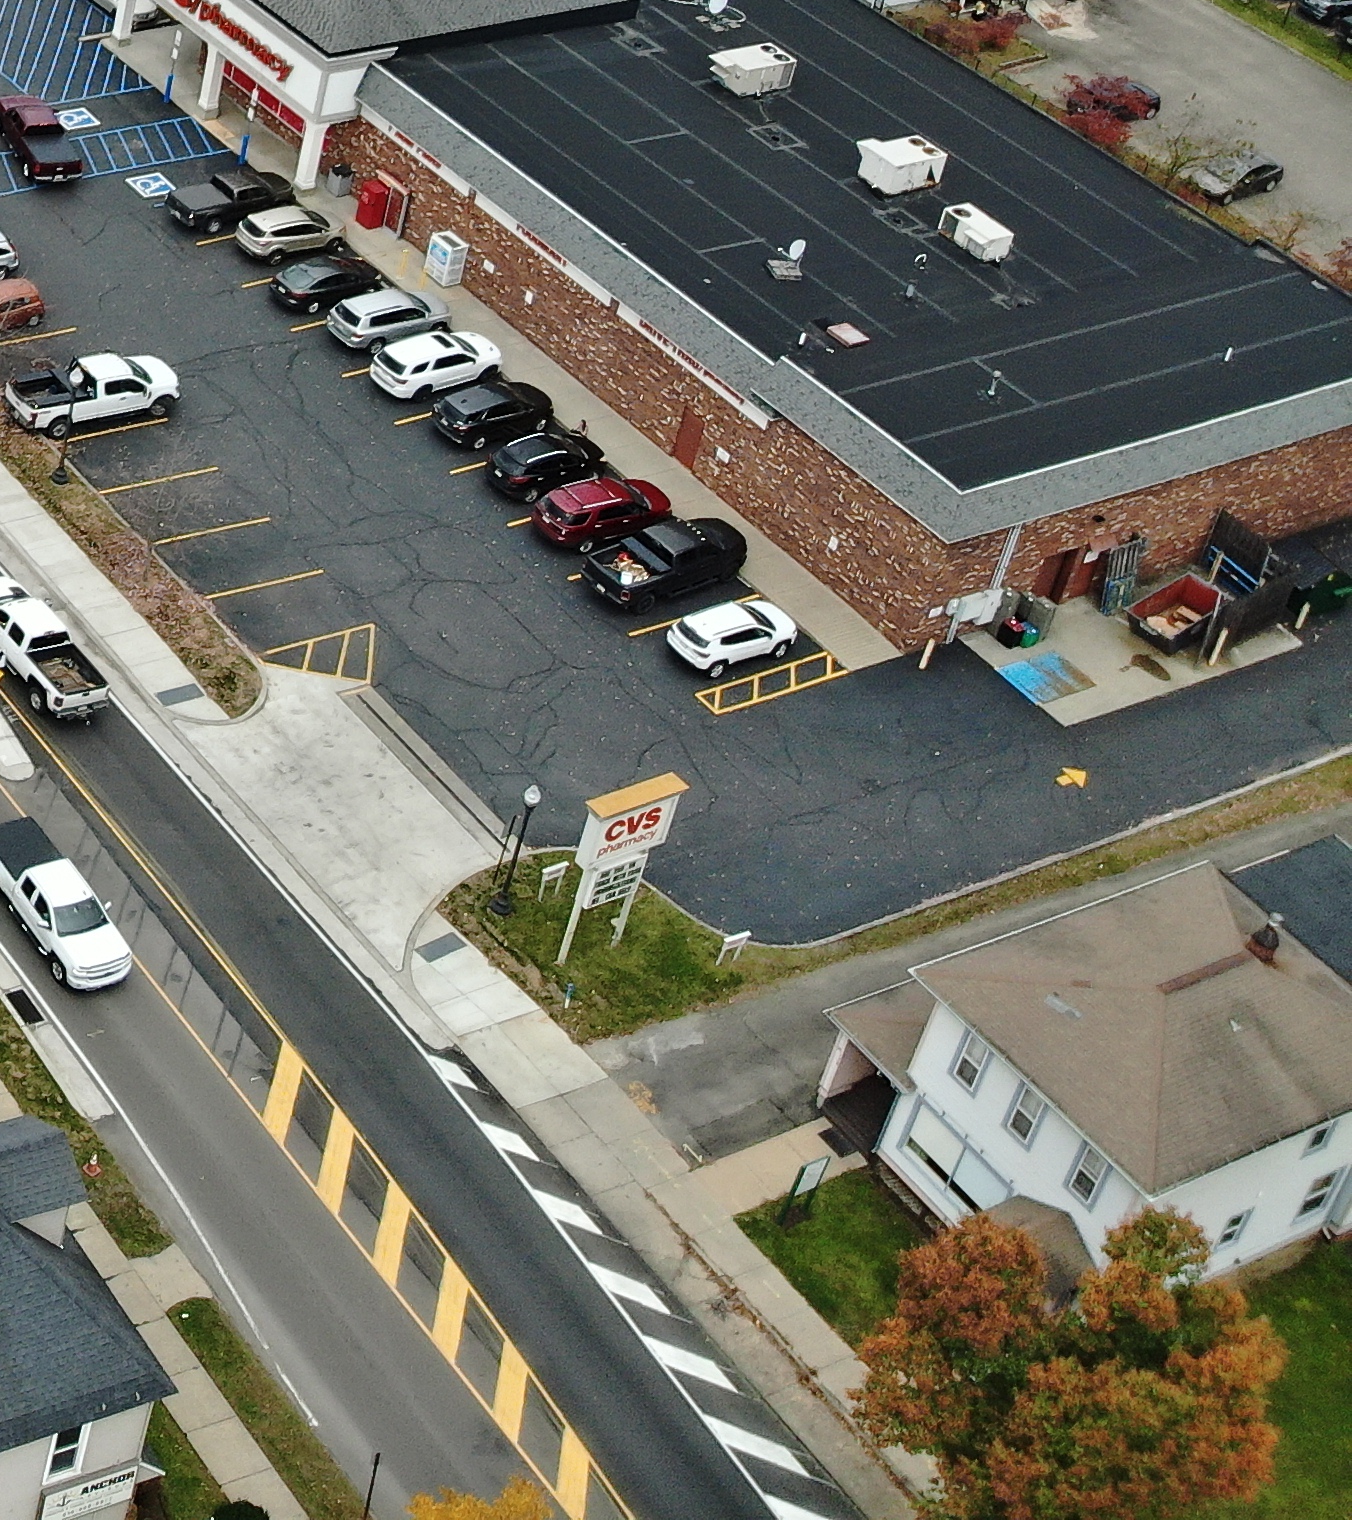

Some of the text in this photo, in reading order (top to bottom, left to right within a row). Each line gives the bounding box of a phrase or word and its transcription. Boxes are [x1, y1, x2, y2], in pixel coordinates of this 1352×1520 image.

[604, 806, 663, 843] CVS
[596, 828, 658, 859] pharmacy
[80, 1470, 135, 1496] ANCHOR
